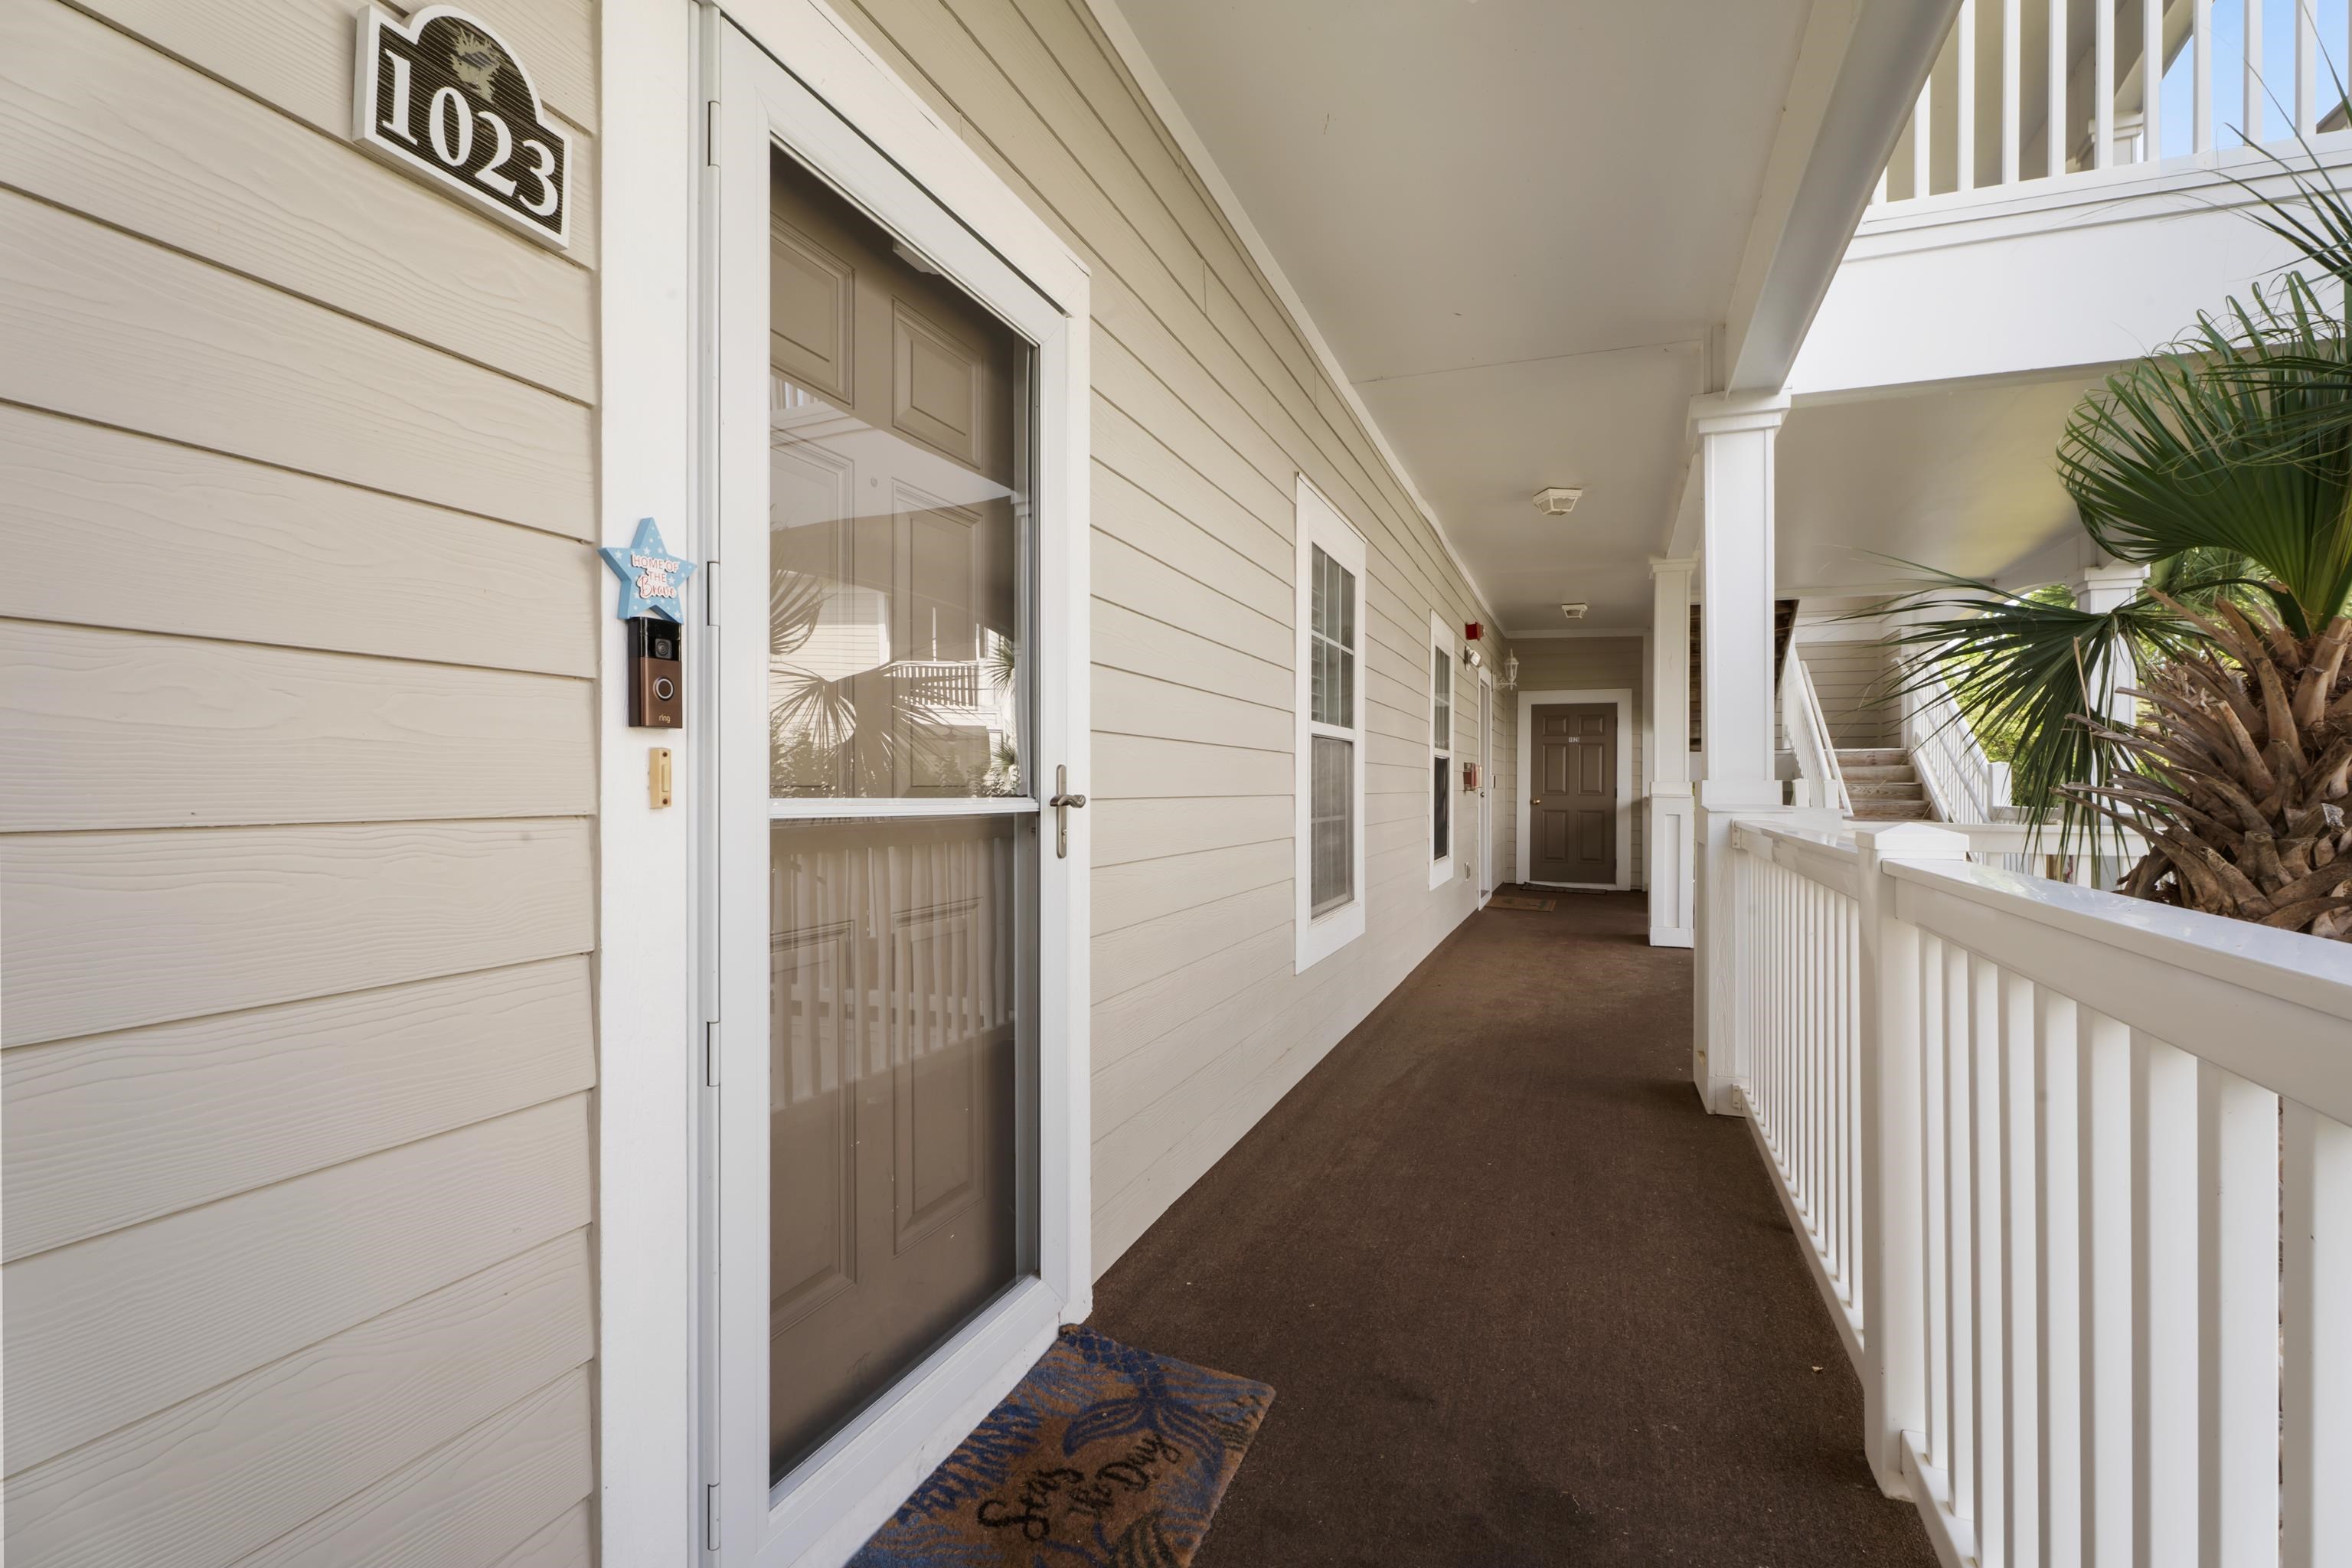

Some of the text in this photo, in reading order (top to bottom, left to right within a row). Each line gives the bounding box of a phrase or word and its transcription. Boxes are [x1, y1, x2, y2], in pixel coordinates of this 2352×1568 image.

[382, 48, 558, 217] 1023
[633, 556, 678, 572] HOME OF
[638, 575, 675, 597] Brave
[648, 570, 666, 583] THE
[658, 714, 671, 724] ring
[1095, 1432, 1180, 1491] Day
